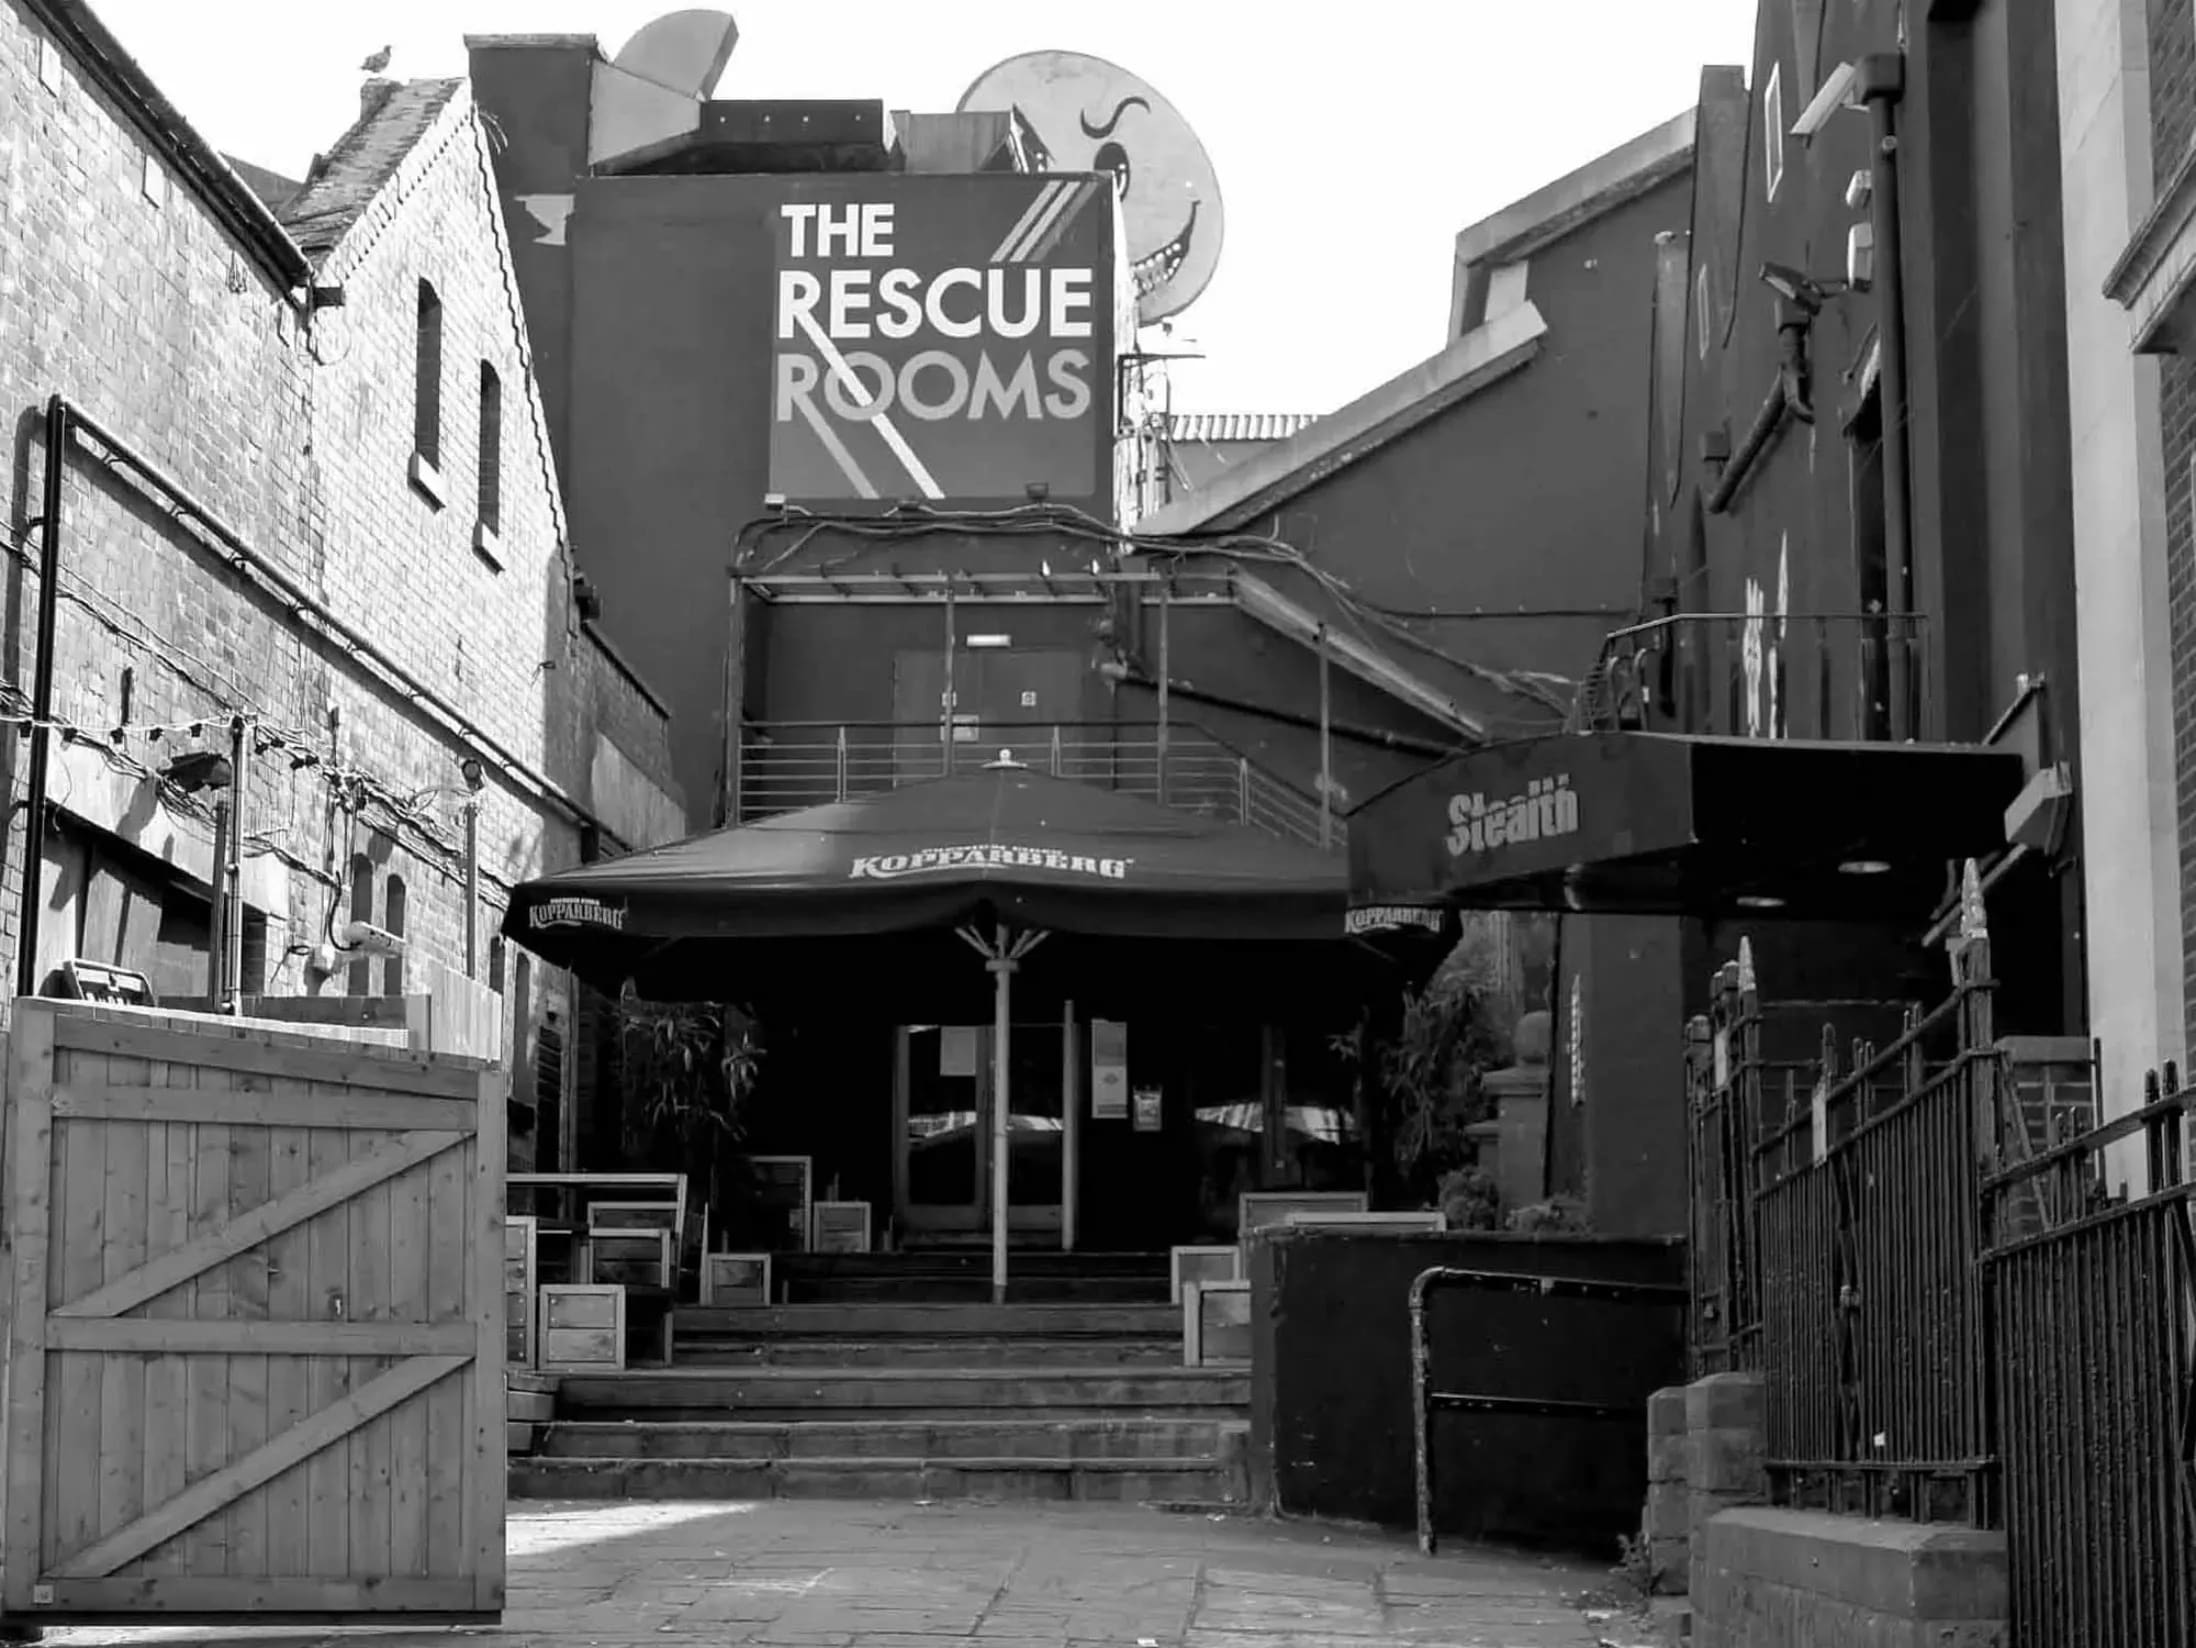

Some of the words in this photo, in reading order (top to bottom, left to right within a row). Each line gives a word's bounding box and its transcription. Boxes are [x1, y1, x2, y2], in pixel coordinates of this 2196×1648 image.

[781, 203, 895, 258] THE
[778, 267, 1093, 339] RESCUE
[777, 349, 1091, 422] ROOMS
[1445, 773, 1579, 857] Stealth
[849, 848, 1128, 879] KOPPARBERG
[529, 901, 624, 930] KOPPARBERG
